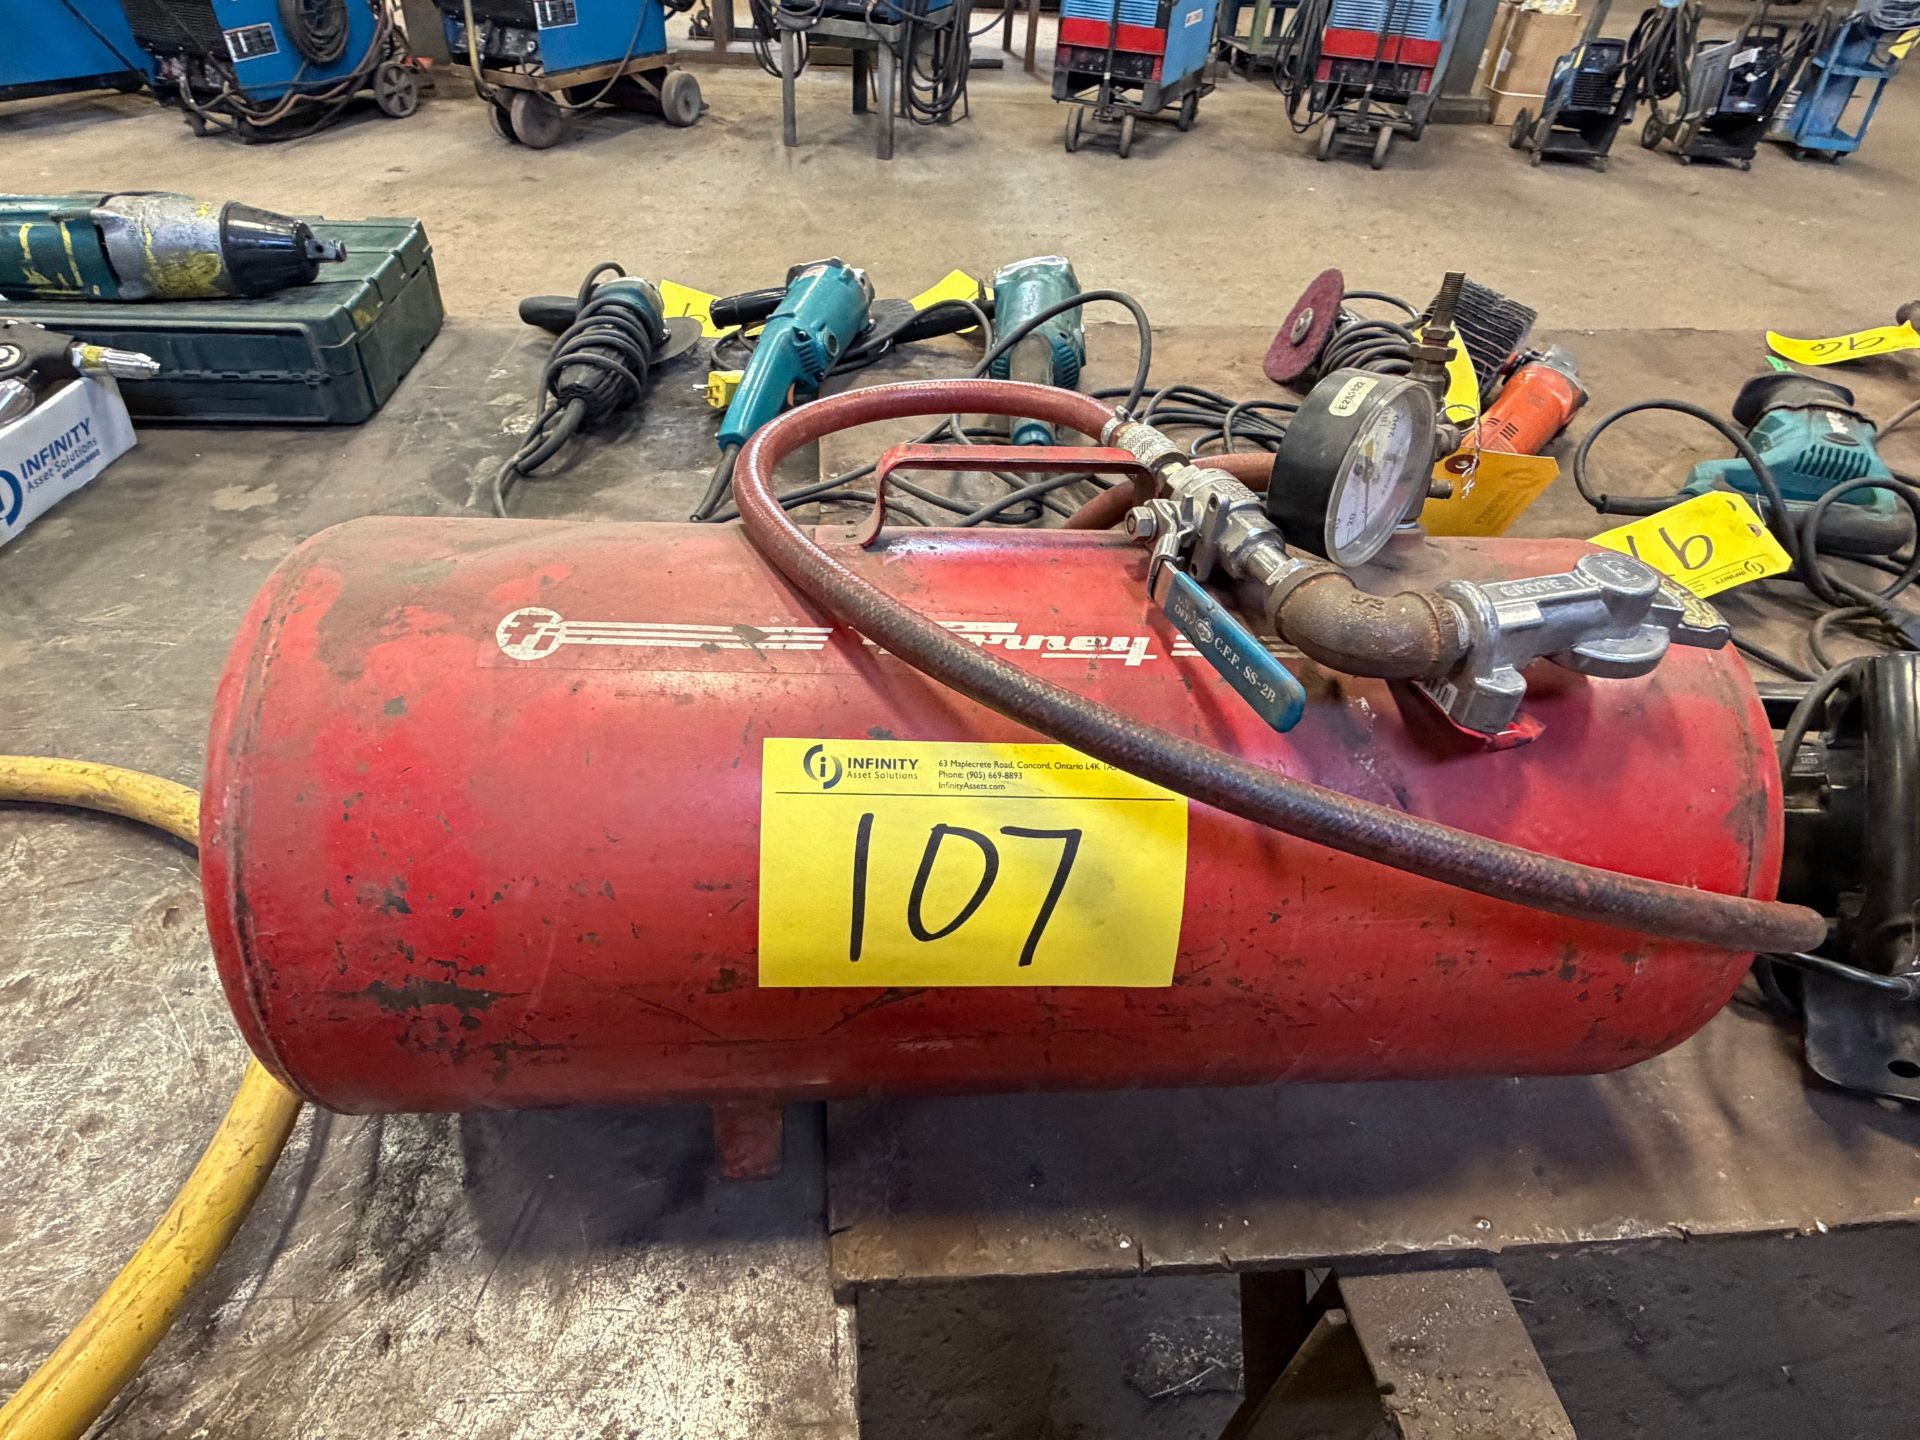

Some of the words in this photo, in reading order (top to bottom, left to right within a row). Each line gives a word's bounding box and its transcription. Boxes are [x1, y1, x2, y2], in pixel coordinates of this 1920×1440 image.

[20, 417, 90, 480] INFINITY
[27, 467, 55, 493] Asset
[54, 437, 98, 473] Solutions
[1214, 636, 1240, 670] C.F.F.
[847, 757, 919, 770] INFINITY
[950, 760, 992, 769] Maplecrete
[994, 760, 1015, 769] Road,
[1017, 761, 1052, 770] Concord,
[1054, 762, 1084, 770] Ontario
[1085, 763, 1101, 771] L4K
[847, 771, 872, 779] Asset
[874, 771, 919, 780] Solutions
[938, 770, 964, 779] Phone:
[966, 771, 986, 780] (905)
[988, 772, 1023, 780] 669-8893
[938, 782, 1006, 791] InfinityAssets.com
[850, 812, 1083, 967] 107
